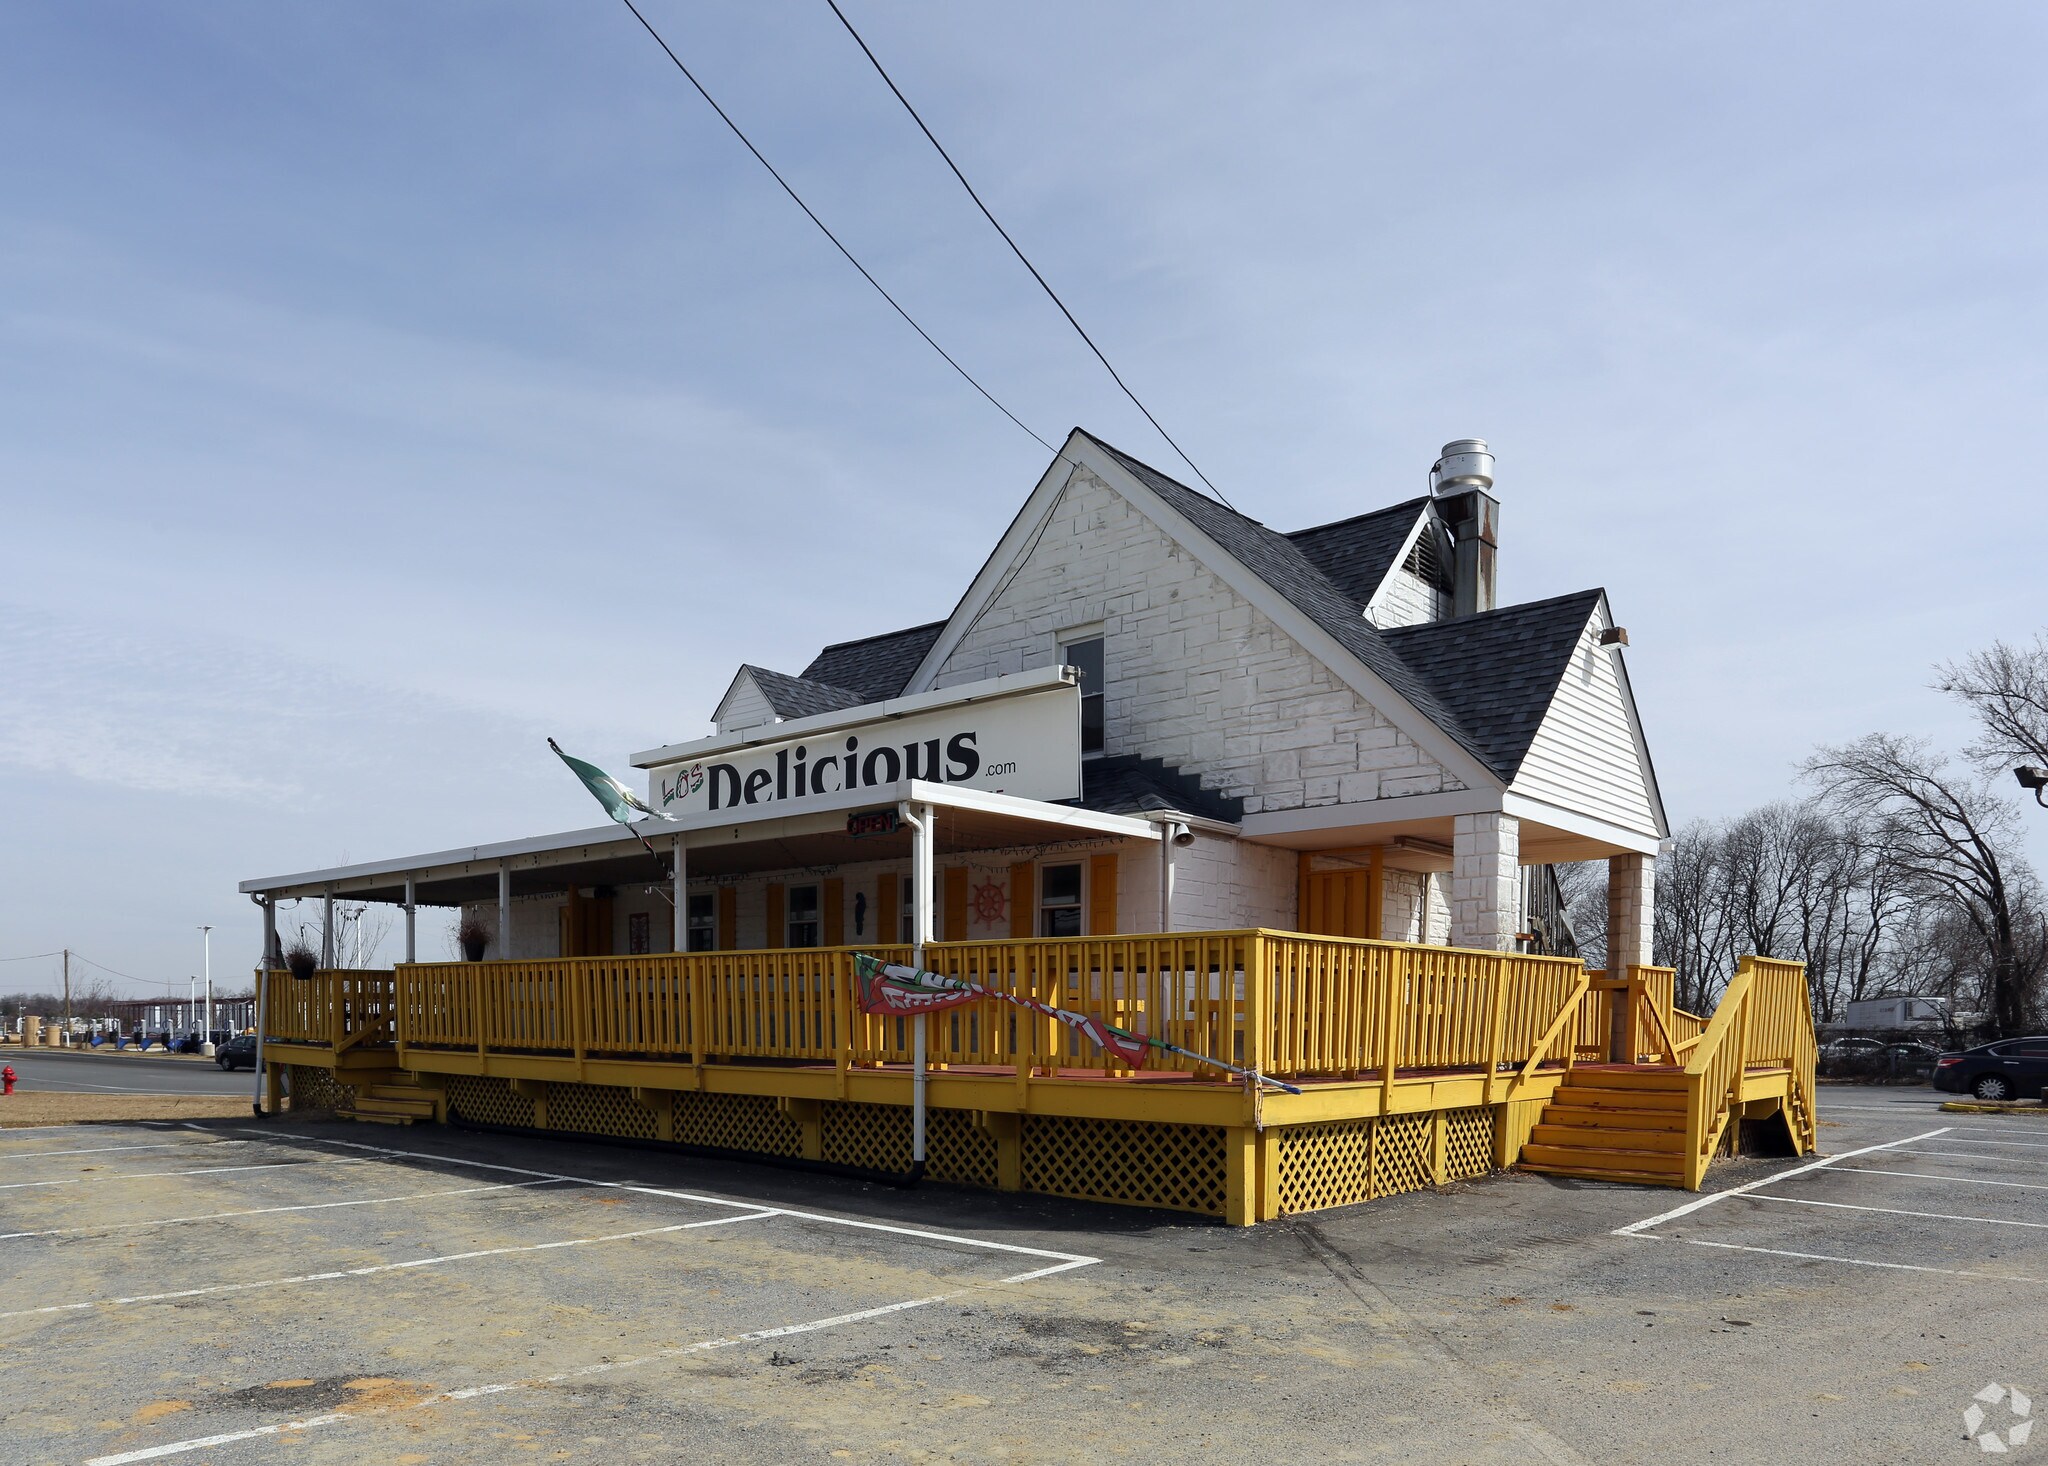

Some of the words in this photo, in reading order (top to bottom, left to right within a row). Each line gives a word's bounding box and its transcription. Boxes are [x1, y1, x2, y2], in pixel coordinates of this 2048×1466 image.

[661, 762, 704, 807] LOS
[707, 731, 980, 811] Delicious
[985, 761, 1016, 777] .com
[846, 812, 893, 835] OPEN
